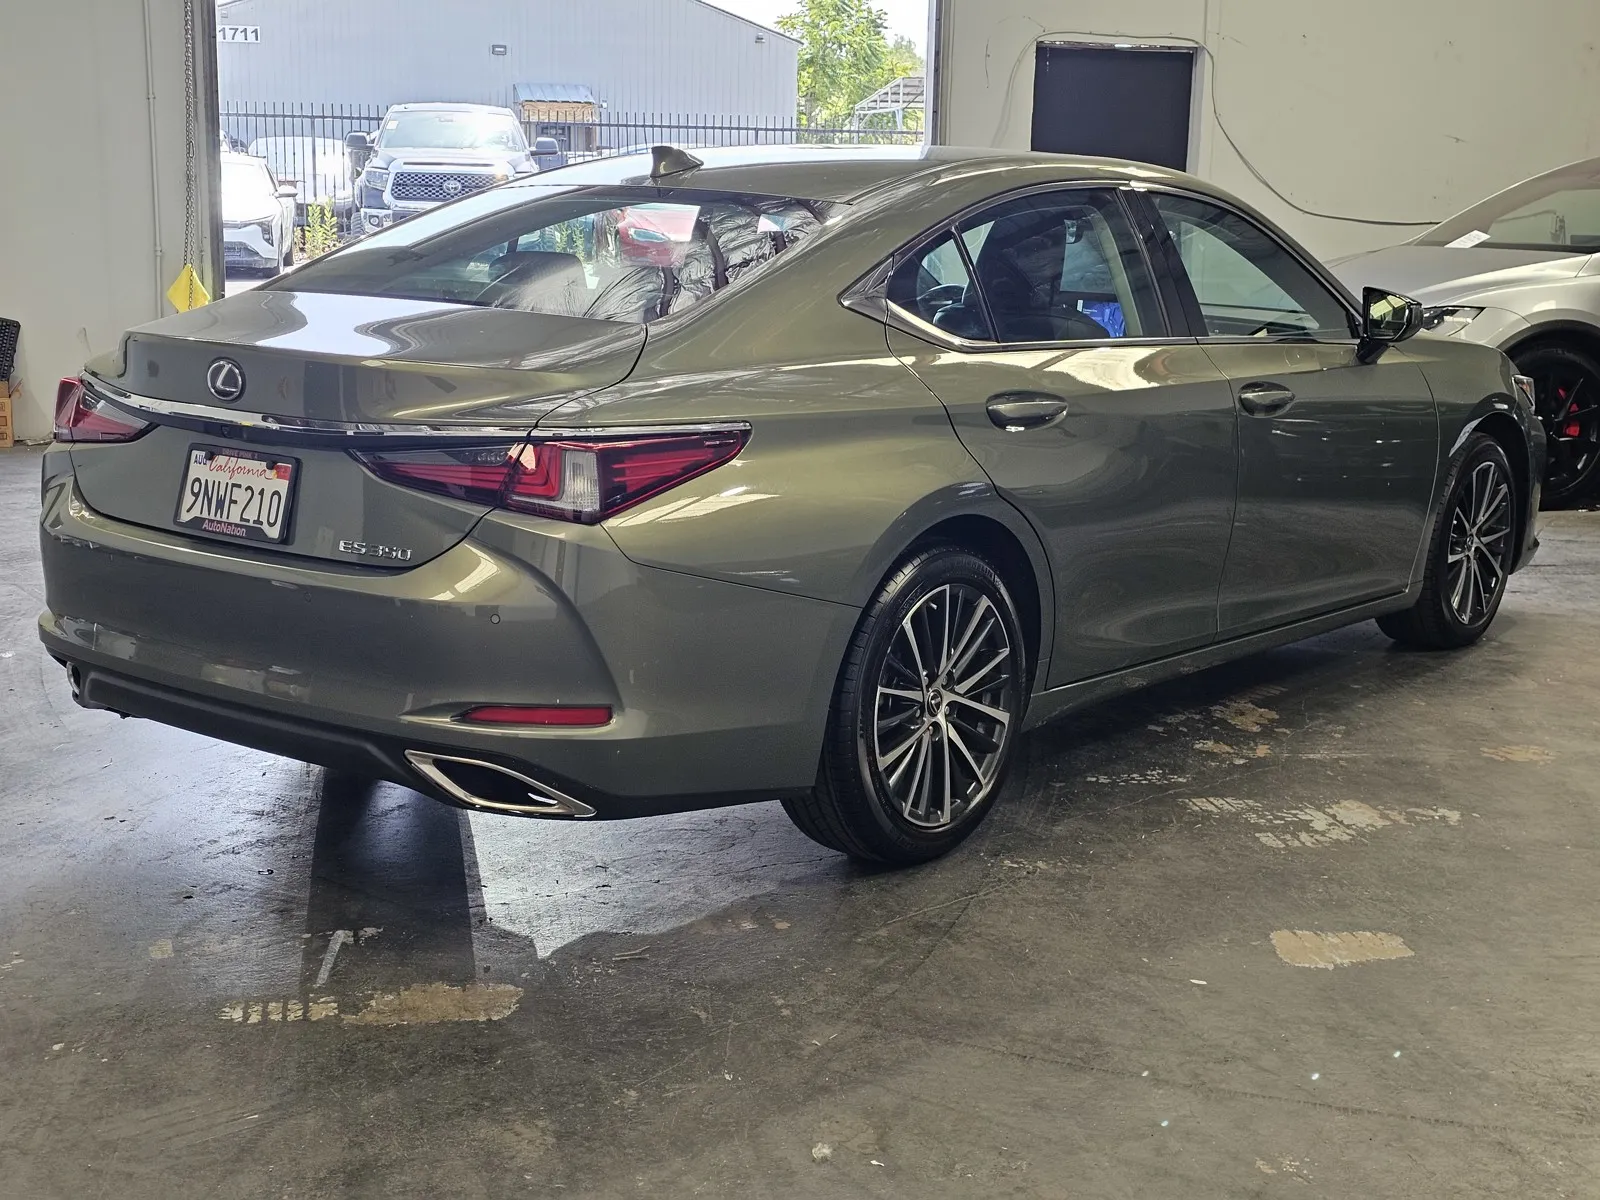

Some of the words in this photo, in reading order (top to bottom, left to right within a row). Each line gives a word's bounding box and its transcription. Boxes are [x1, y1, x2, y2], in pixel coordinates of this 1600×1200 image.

[218, 27, 259, 41] 1711
[208, 455, 274, 480] California
[186, 477, 282, 527] 9NWF210
[202, 520, 247, 537] AutoNation
[339, 540, 366, 555] ES
[368, 543, 412, 561] 350
